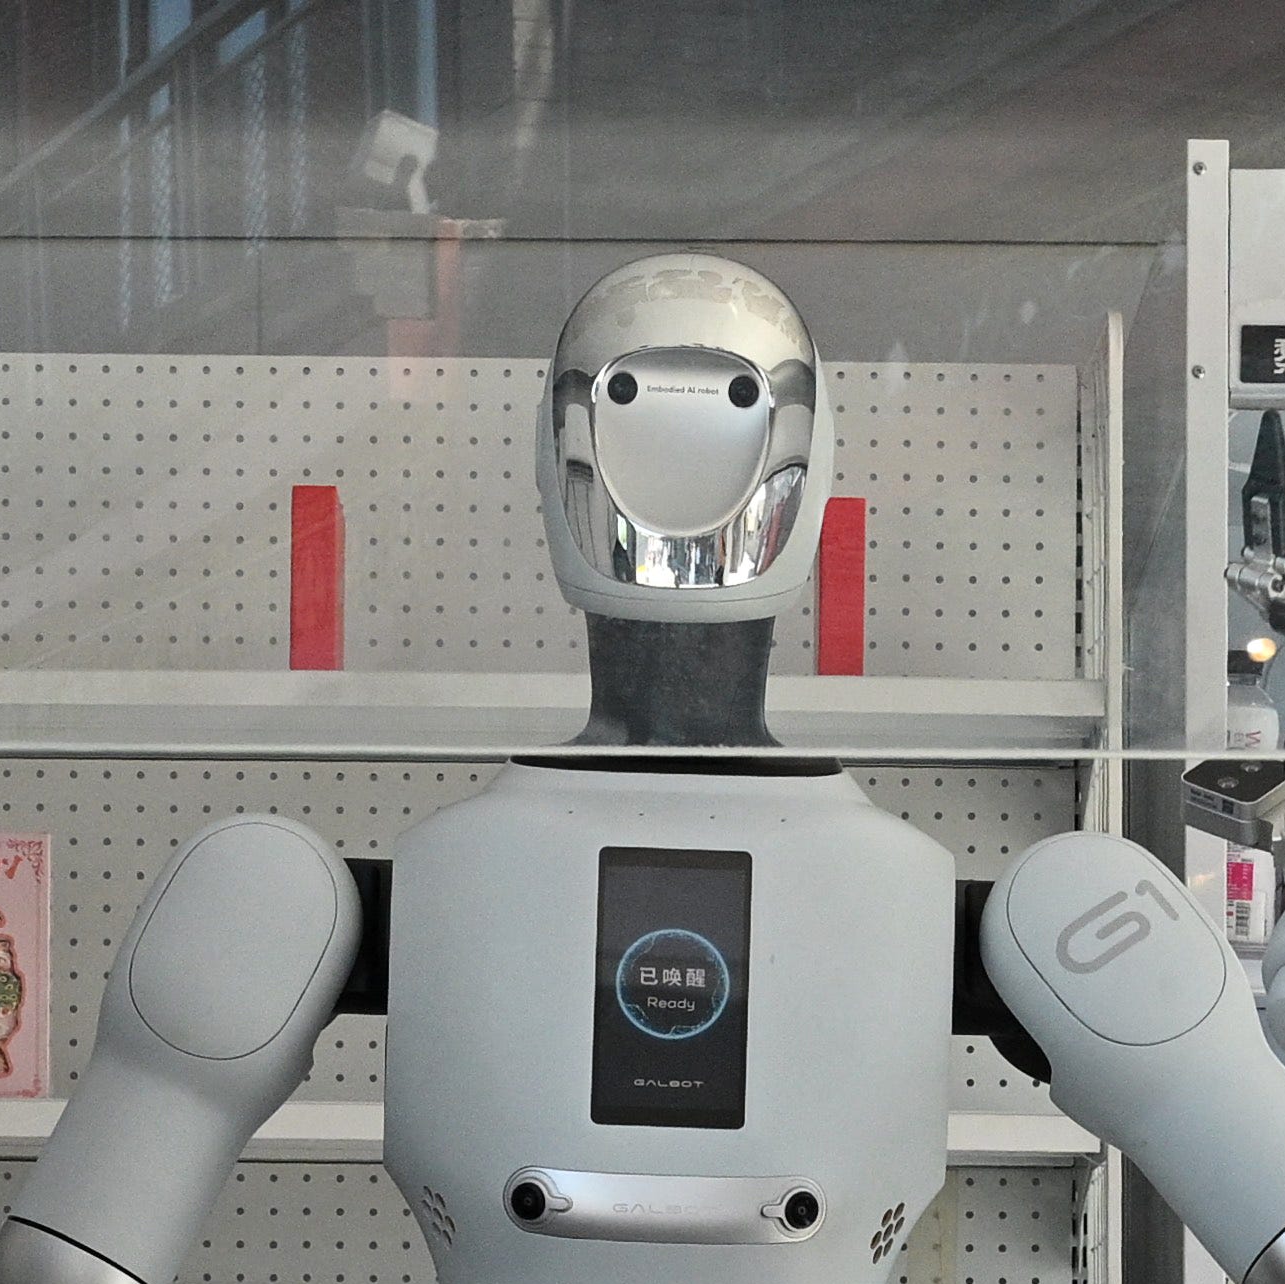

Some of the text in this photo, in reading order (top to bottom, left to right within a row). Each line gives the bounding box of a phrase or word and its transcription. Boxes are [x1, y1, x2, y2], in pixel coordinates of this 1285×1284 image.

[647, 385, 719, 395] Embodied AI robot
[639, 966, 706, 988] 已唤醒
[647, 997, 696, 1011] Ready
[633, 1078, 704, 1088] GALBOT
